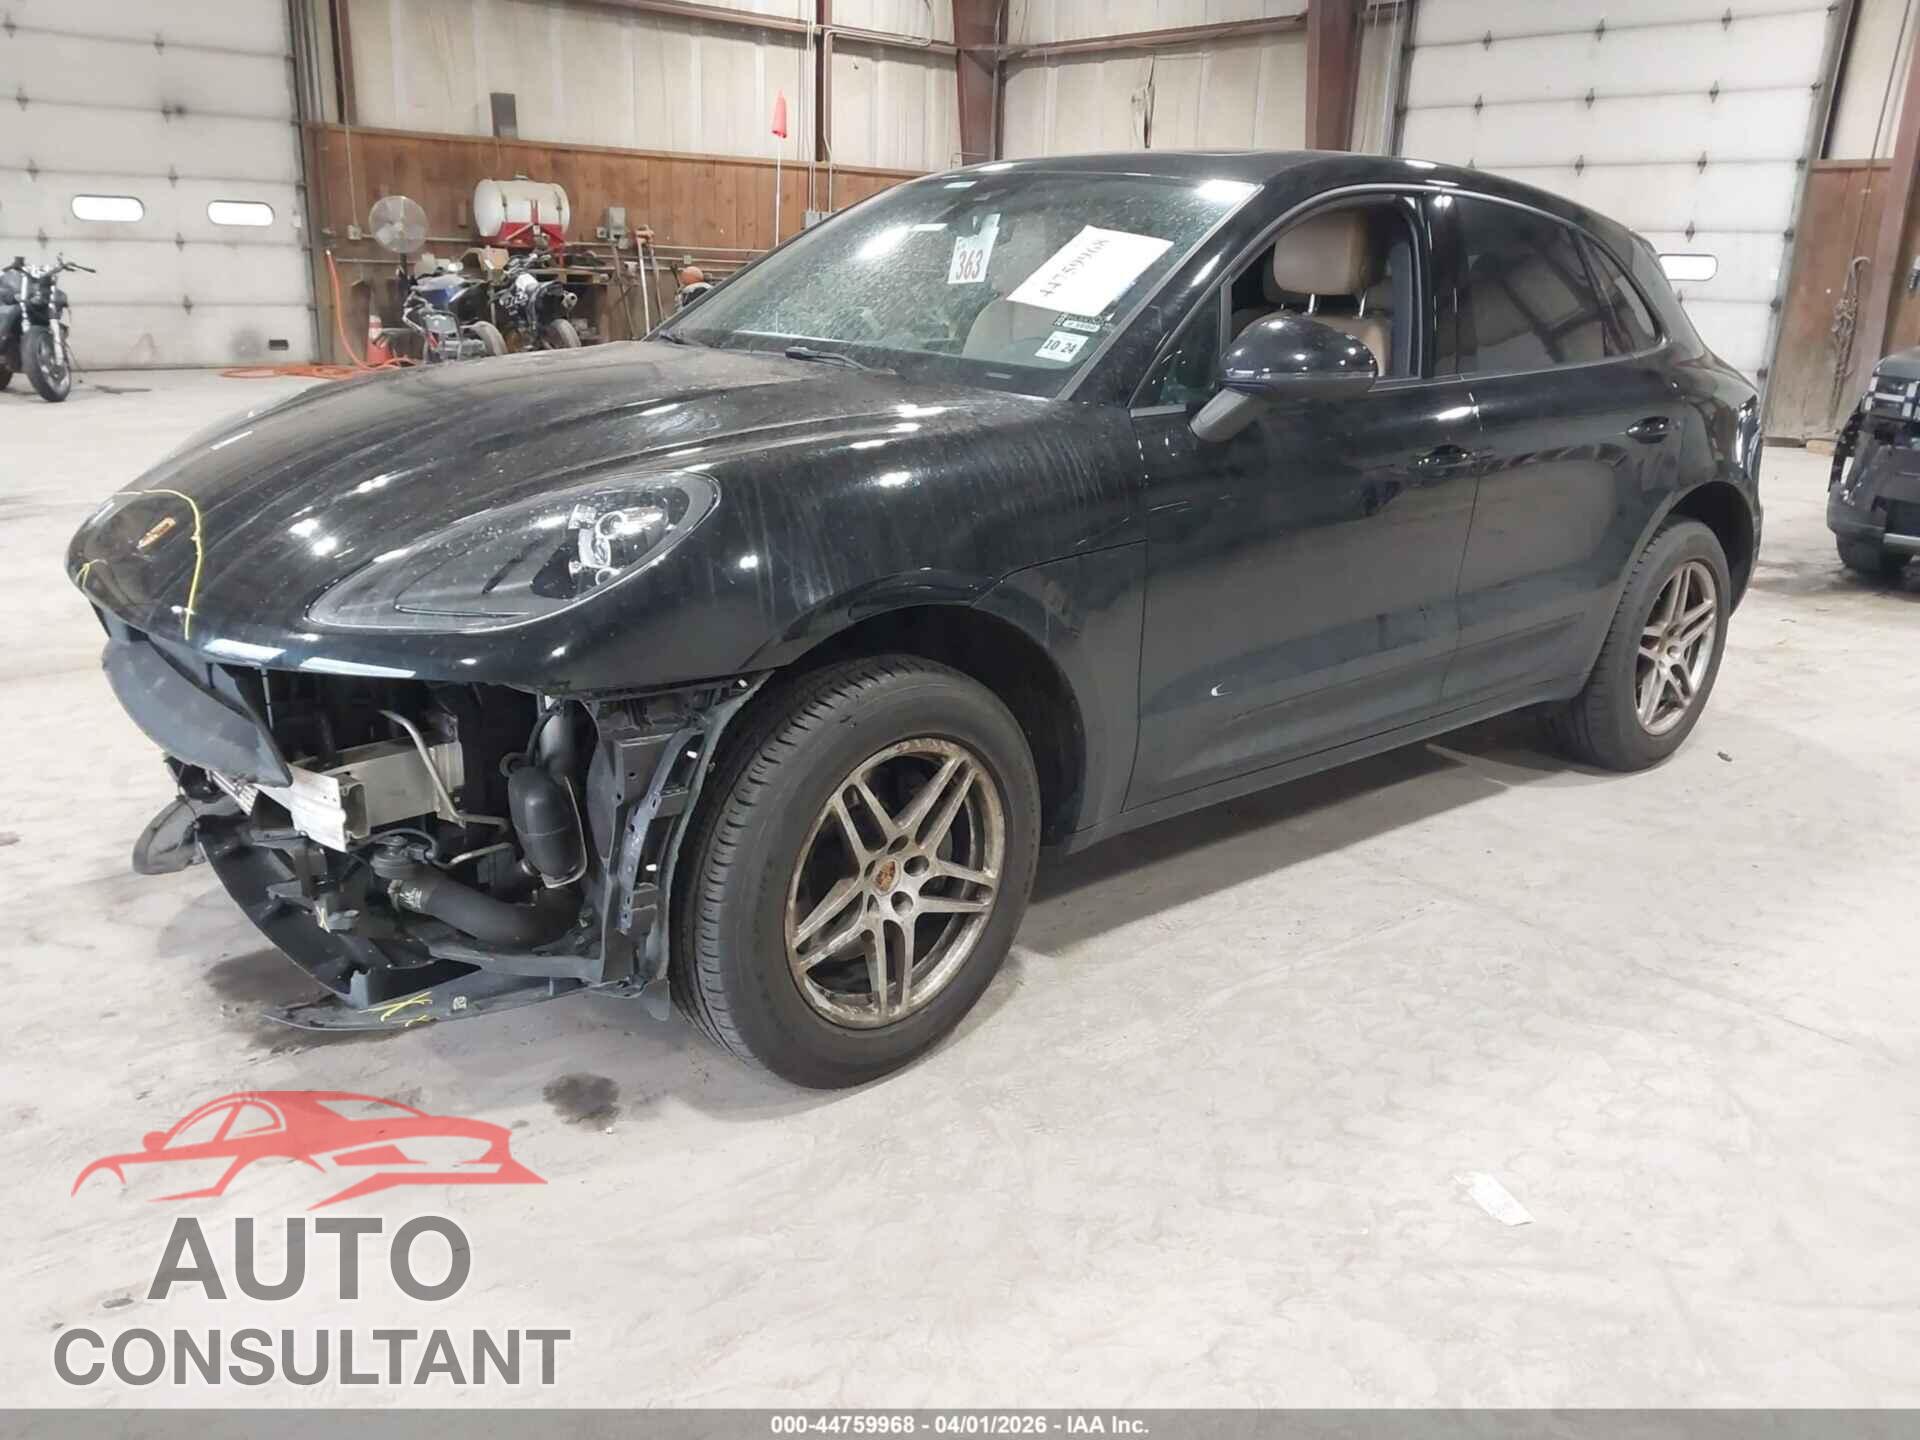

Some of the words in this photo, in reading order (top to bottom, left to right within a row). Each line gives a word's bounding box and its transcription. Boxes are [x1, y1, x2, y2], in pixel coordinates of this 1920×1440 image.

[957, 249, 984, 280] 363
[1043, 339, 1061, 351] 10
[1061, 342, 1078, 354] 24
